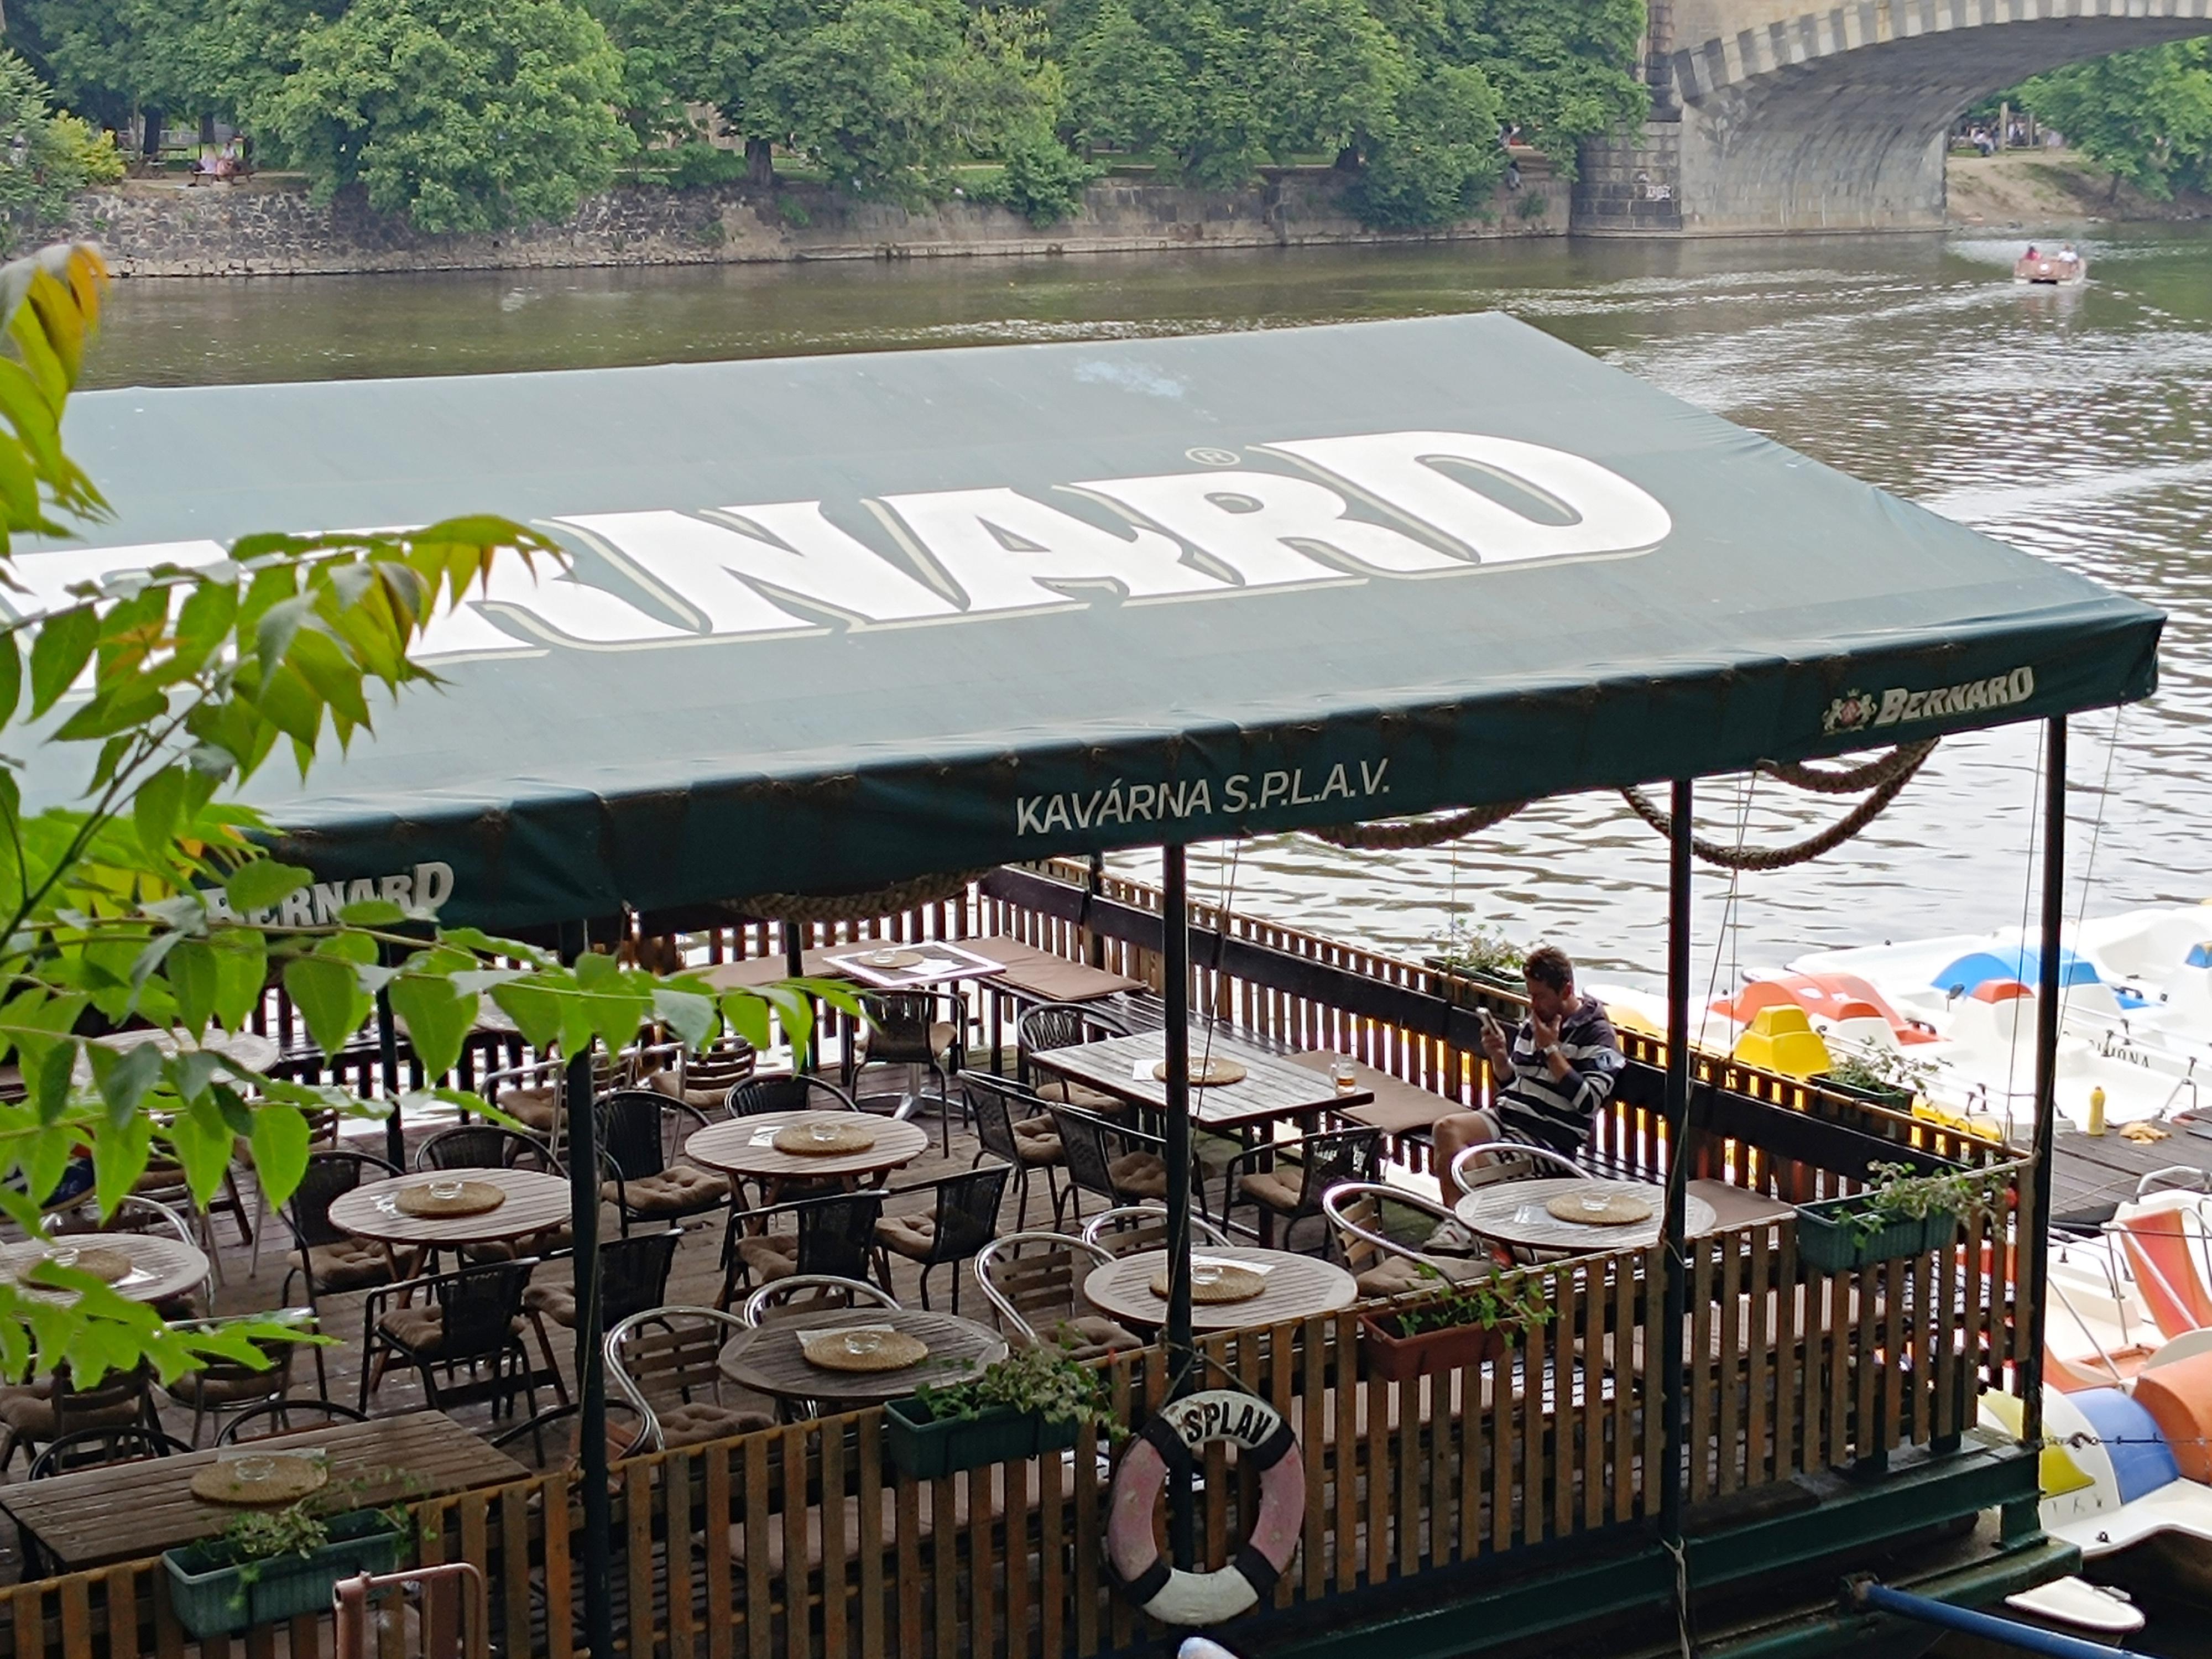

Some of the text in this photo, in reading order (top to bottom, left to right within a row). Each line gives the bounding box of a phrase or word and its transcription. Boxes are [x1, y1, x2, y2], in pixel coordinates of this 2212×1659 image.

[1874, 666, 2035, 725] BERNARD
[1016, 758, 1390, 836] KAVÁRNA S.P.L.A.V.
[1185, 1401, 1273, 1445] SPLAV
